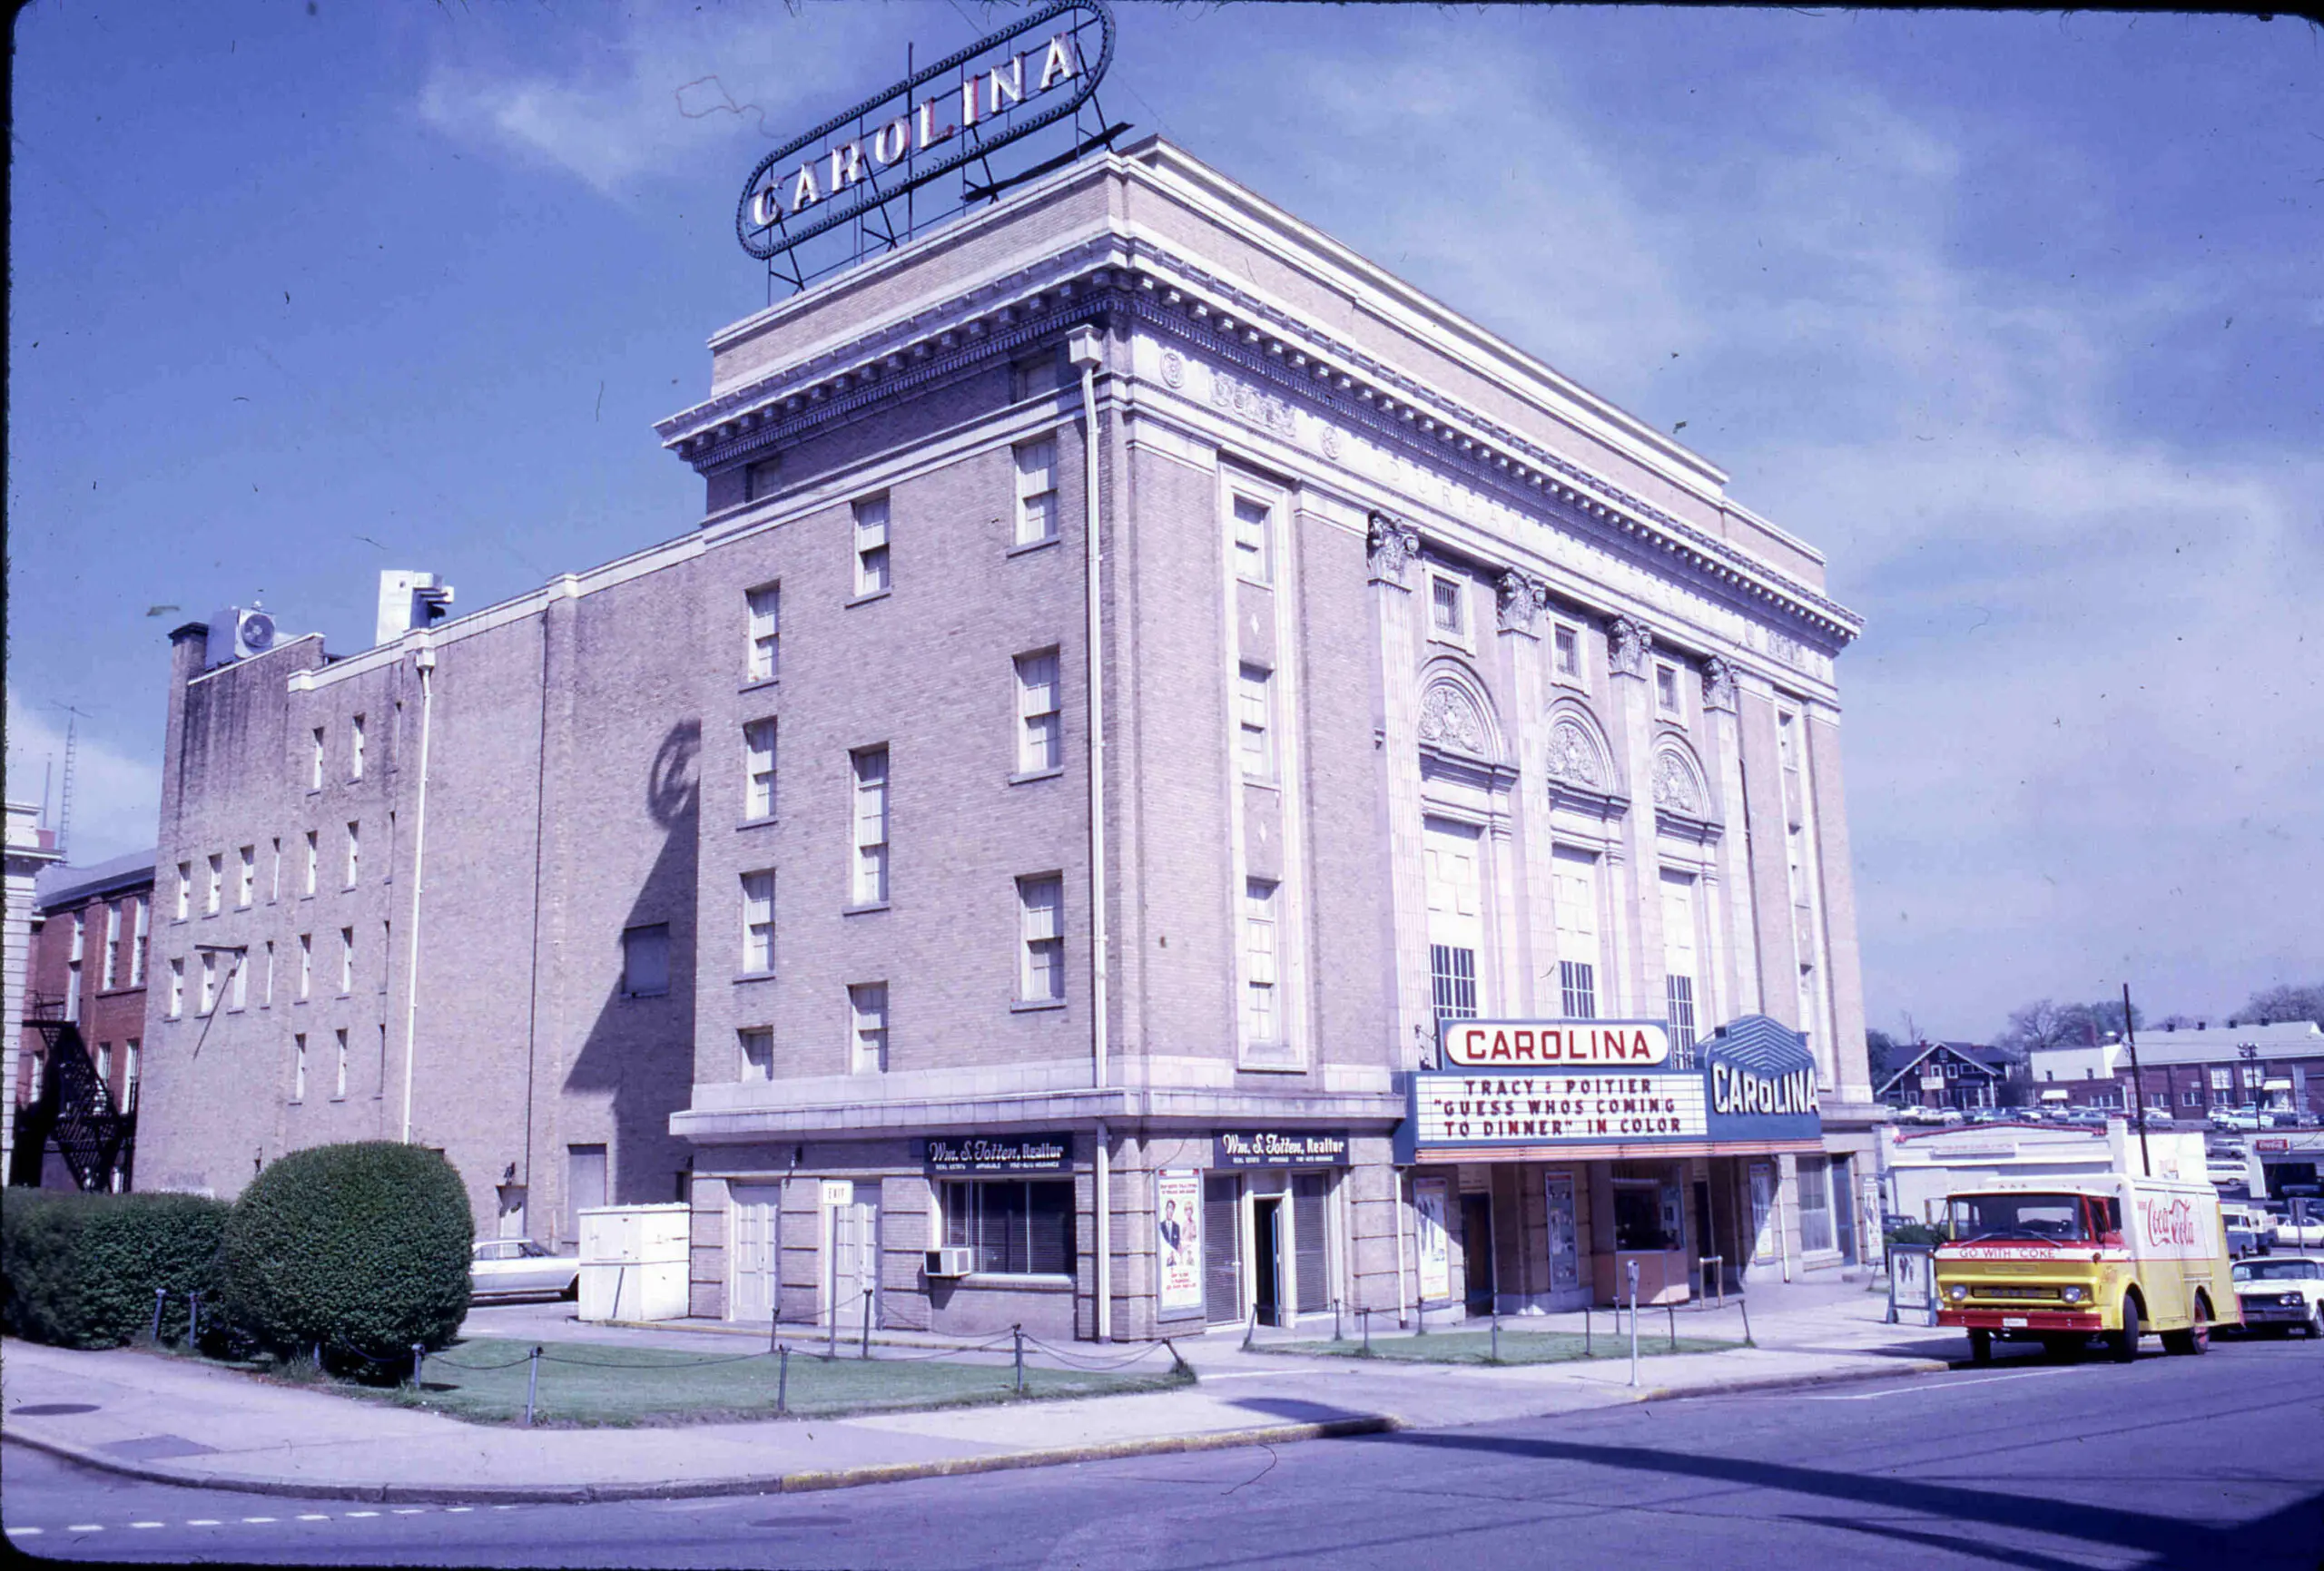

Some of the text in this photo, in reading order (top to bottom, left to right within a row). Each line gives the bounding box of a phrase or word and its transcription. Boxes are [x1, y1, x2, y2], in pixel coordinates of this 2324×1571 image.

[753, 32, 1079, 226] CAROLINA
[1465, 1029, 1651, 1059] CAROLINA
[1465, 1079, 1533, 1095] TRACY
[1566, 1078, 1651, 1095] POITIER
[1711, 1060, 1820, 1114] CAROLINA
[1434, 1098, 1675, 1116] "GUESS WHOS COMING
[1444, 1117, 1680, 1136] TO DINNER" IN COLOR
[929, 1142, 959, 1162] Wm.
[1022, 1143, 1064, 1159] Realtor
[1223, 1134, 1251, 1154] Wm.
[1306, 1138, 1344, 1154] Realtor
[1959, 1247, 1977, 1259] GO
[1983, 1247, 2011, 1259] WITH
